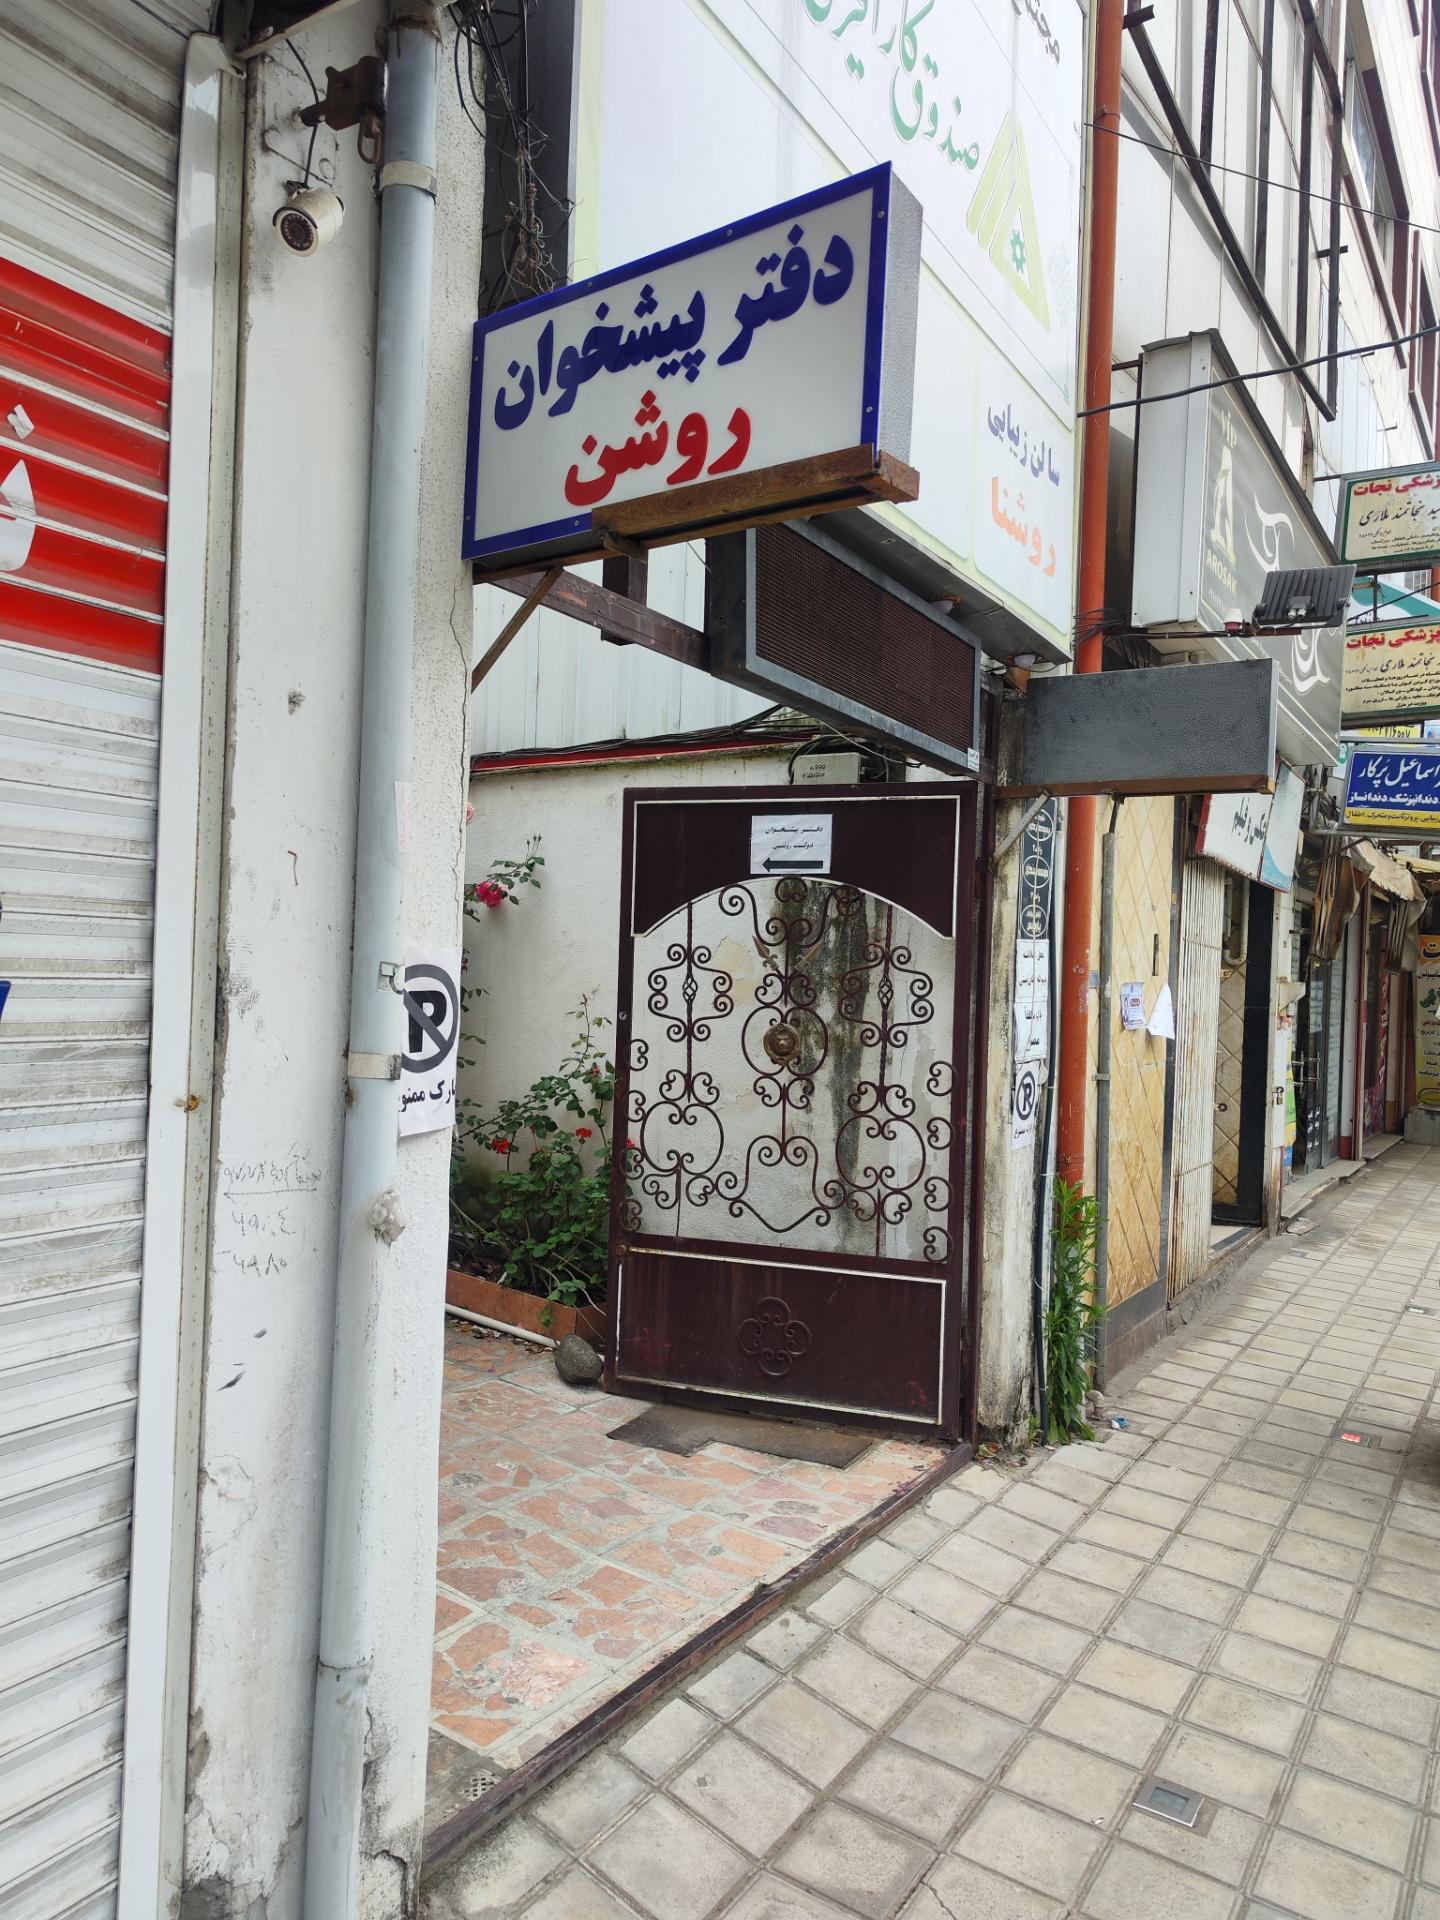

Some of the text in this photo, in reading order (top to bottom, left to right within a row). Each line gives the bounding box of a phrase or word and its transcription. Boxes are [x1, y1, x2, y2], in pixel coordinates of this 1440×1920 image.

[494, 224, 854, 430] دفتر پیشخوان
[565, 390, 751, 506] روشن
[988, 403, 1060, 487] سالن زیبایی
[1354, 474, 1440, 496] زشکی نجات
[992, 476, 1056, 578] روشنا
[1206, 548, 1238, 595] AROSAK
[1346, 633, 1386, 650] نجات
[399, 1078, 456, 1112] ارک ممنو
